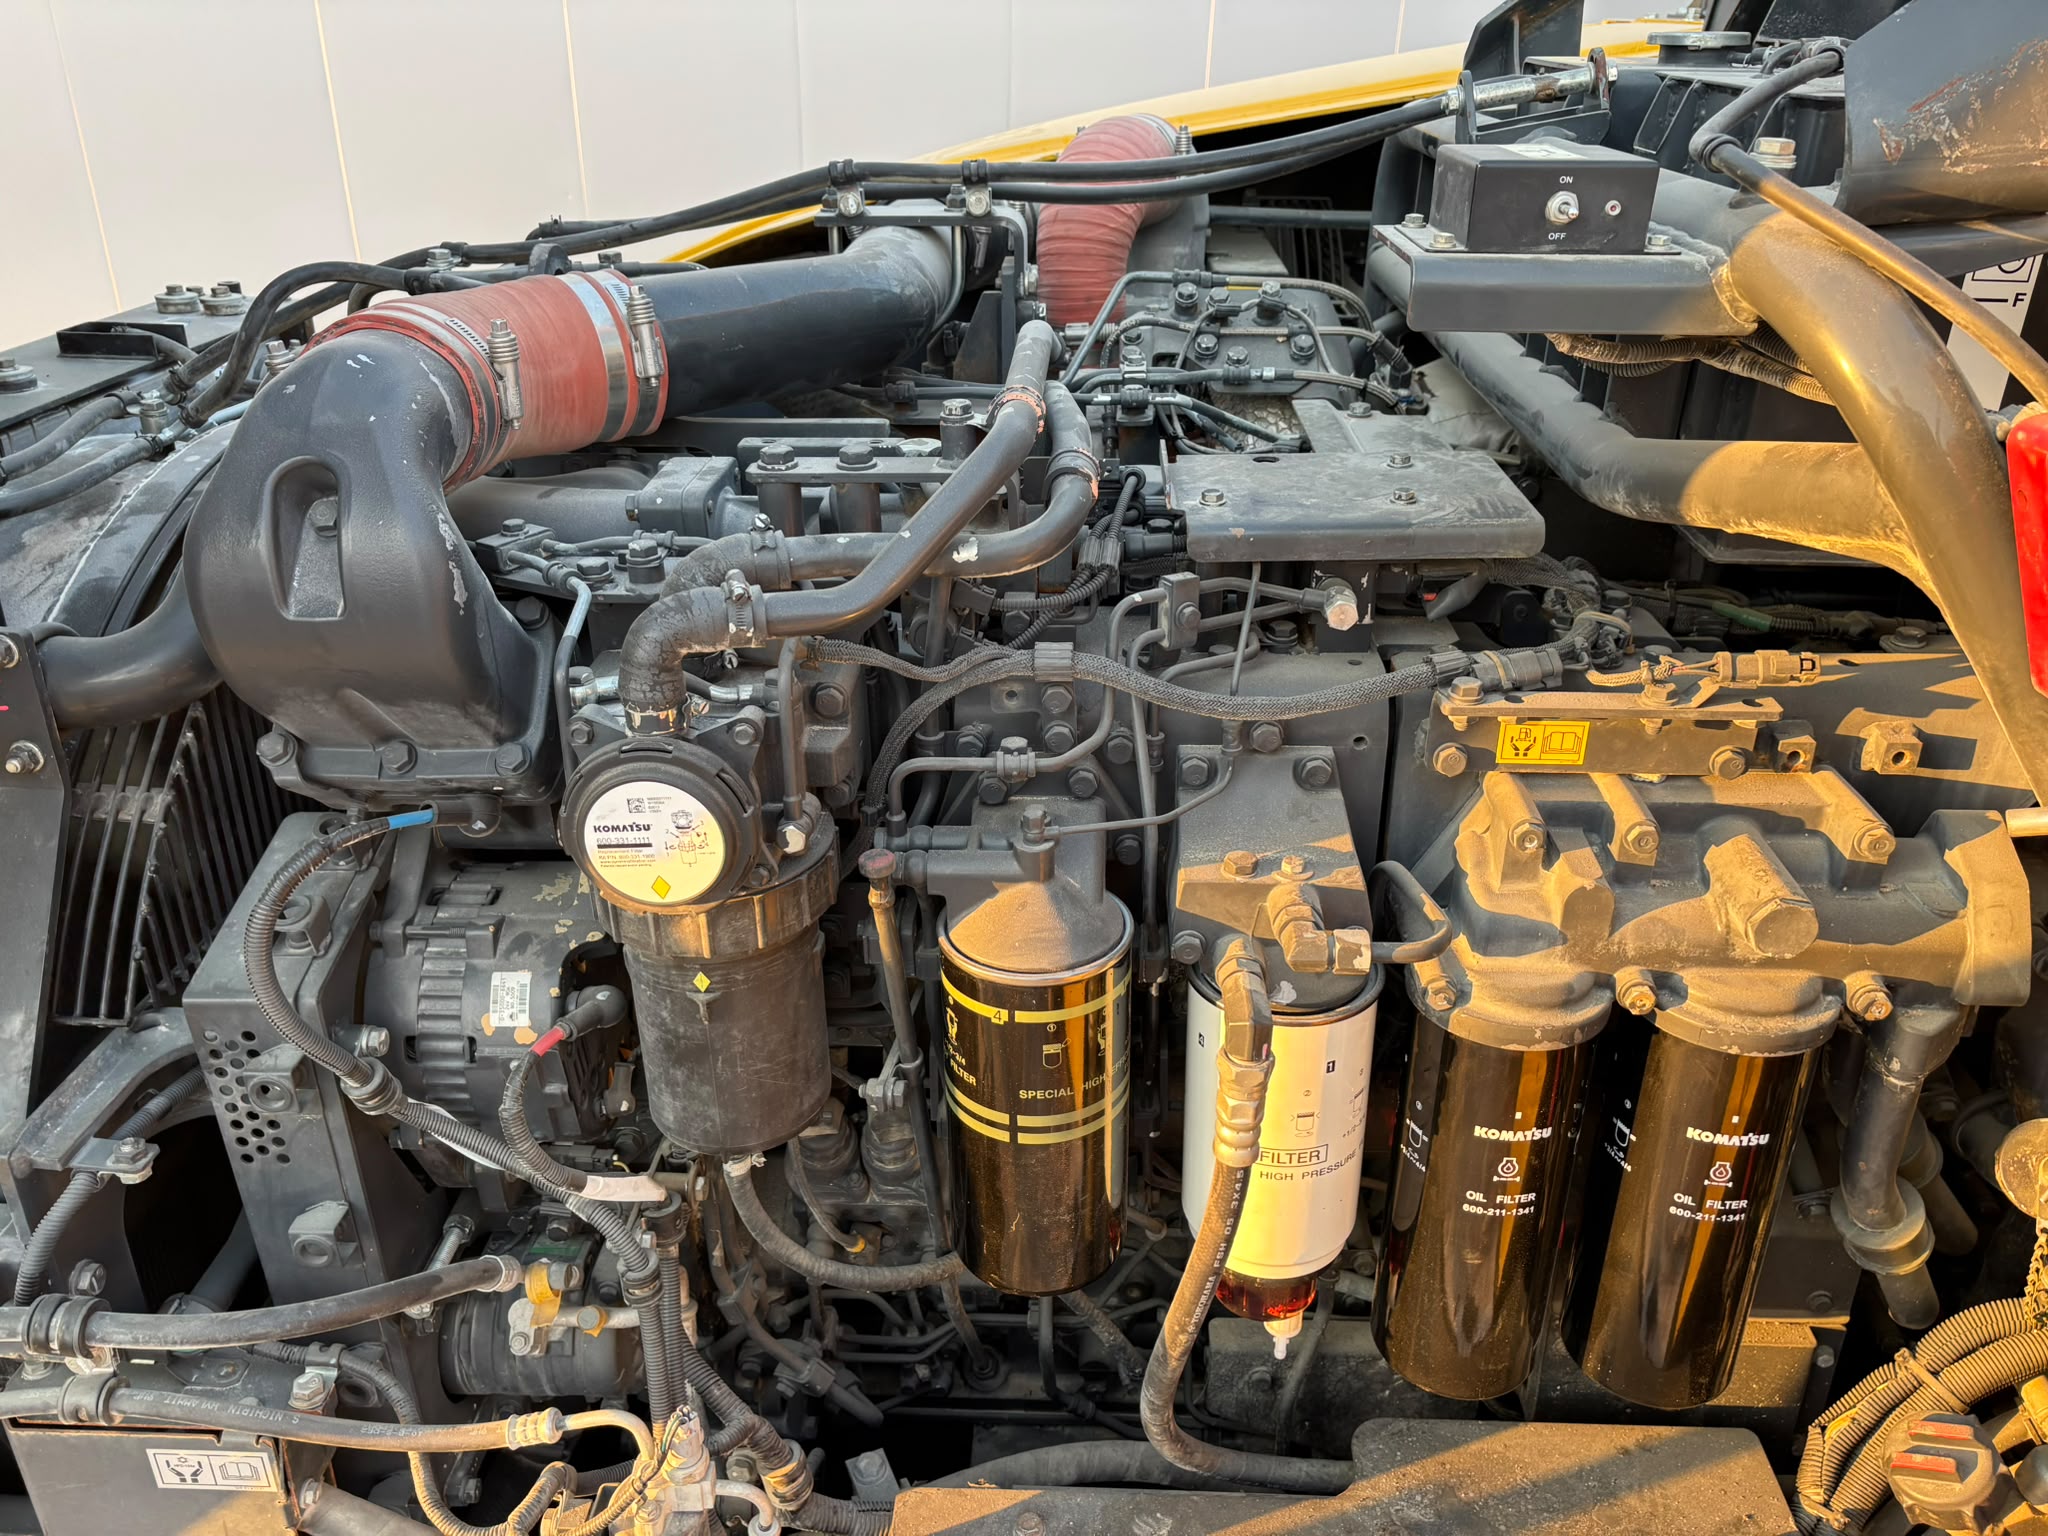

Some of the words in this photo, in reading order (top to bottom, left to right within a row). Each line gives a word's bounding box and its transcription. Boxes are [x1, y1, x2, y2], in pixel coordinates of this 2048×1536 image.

[1559, 175, 1573, 184] ON
[1548, 232, 1567, 240] OFF
[2012, 292, 2027, 307] F
[593, 822, 651, 833] KOMATSU
[993, 1010, 1002, 1022] 4
[950, 1058, 977, 1086] FILTER
[1019, 1089, 1074, 1099] SPECIAL
[1082, 1073, 1106, 1091] HIGH
[1473, 1125, 1552, 1142] KOMATSU
[1686, 1127, 1770, 1146] KOMATSU
[1260, 1150, 1321, 1164] FILTER
[1260, 1171, 1294, 1181] HIGH
[1302, 1151, 1357, 1180] PRESSURE
[1465, 1190, 1487, 1203] OIL
[1496, 1192, 1536, 1204] FILTER
[1673, 1193, 1696, 1206] OIL
[1706, 1199, 1748, 1210] FILTER
[1462, 1203, 1535, 1216] 600-211-1341
[1669, 1206, 1746, 1222] 600-211-1341
[1192, 1275, 1217, 1324] YOKOHAMA
[227, 1405, 284, 1422] NICHIRIN
